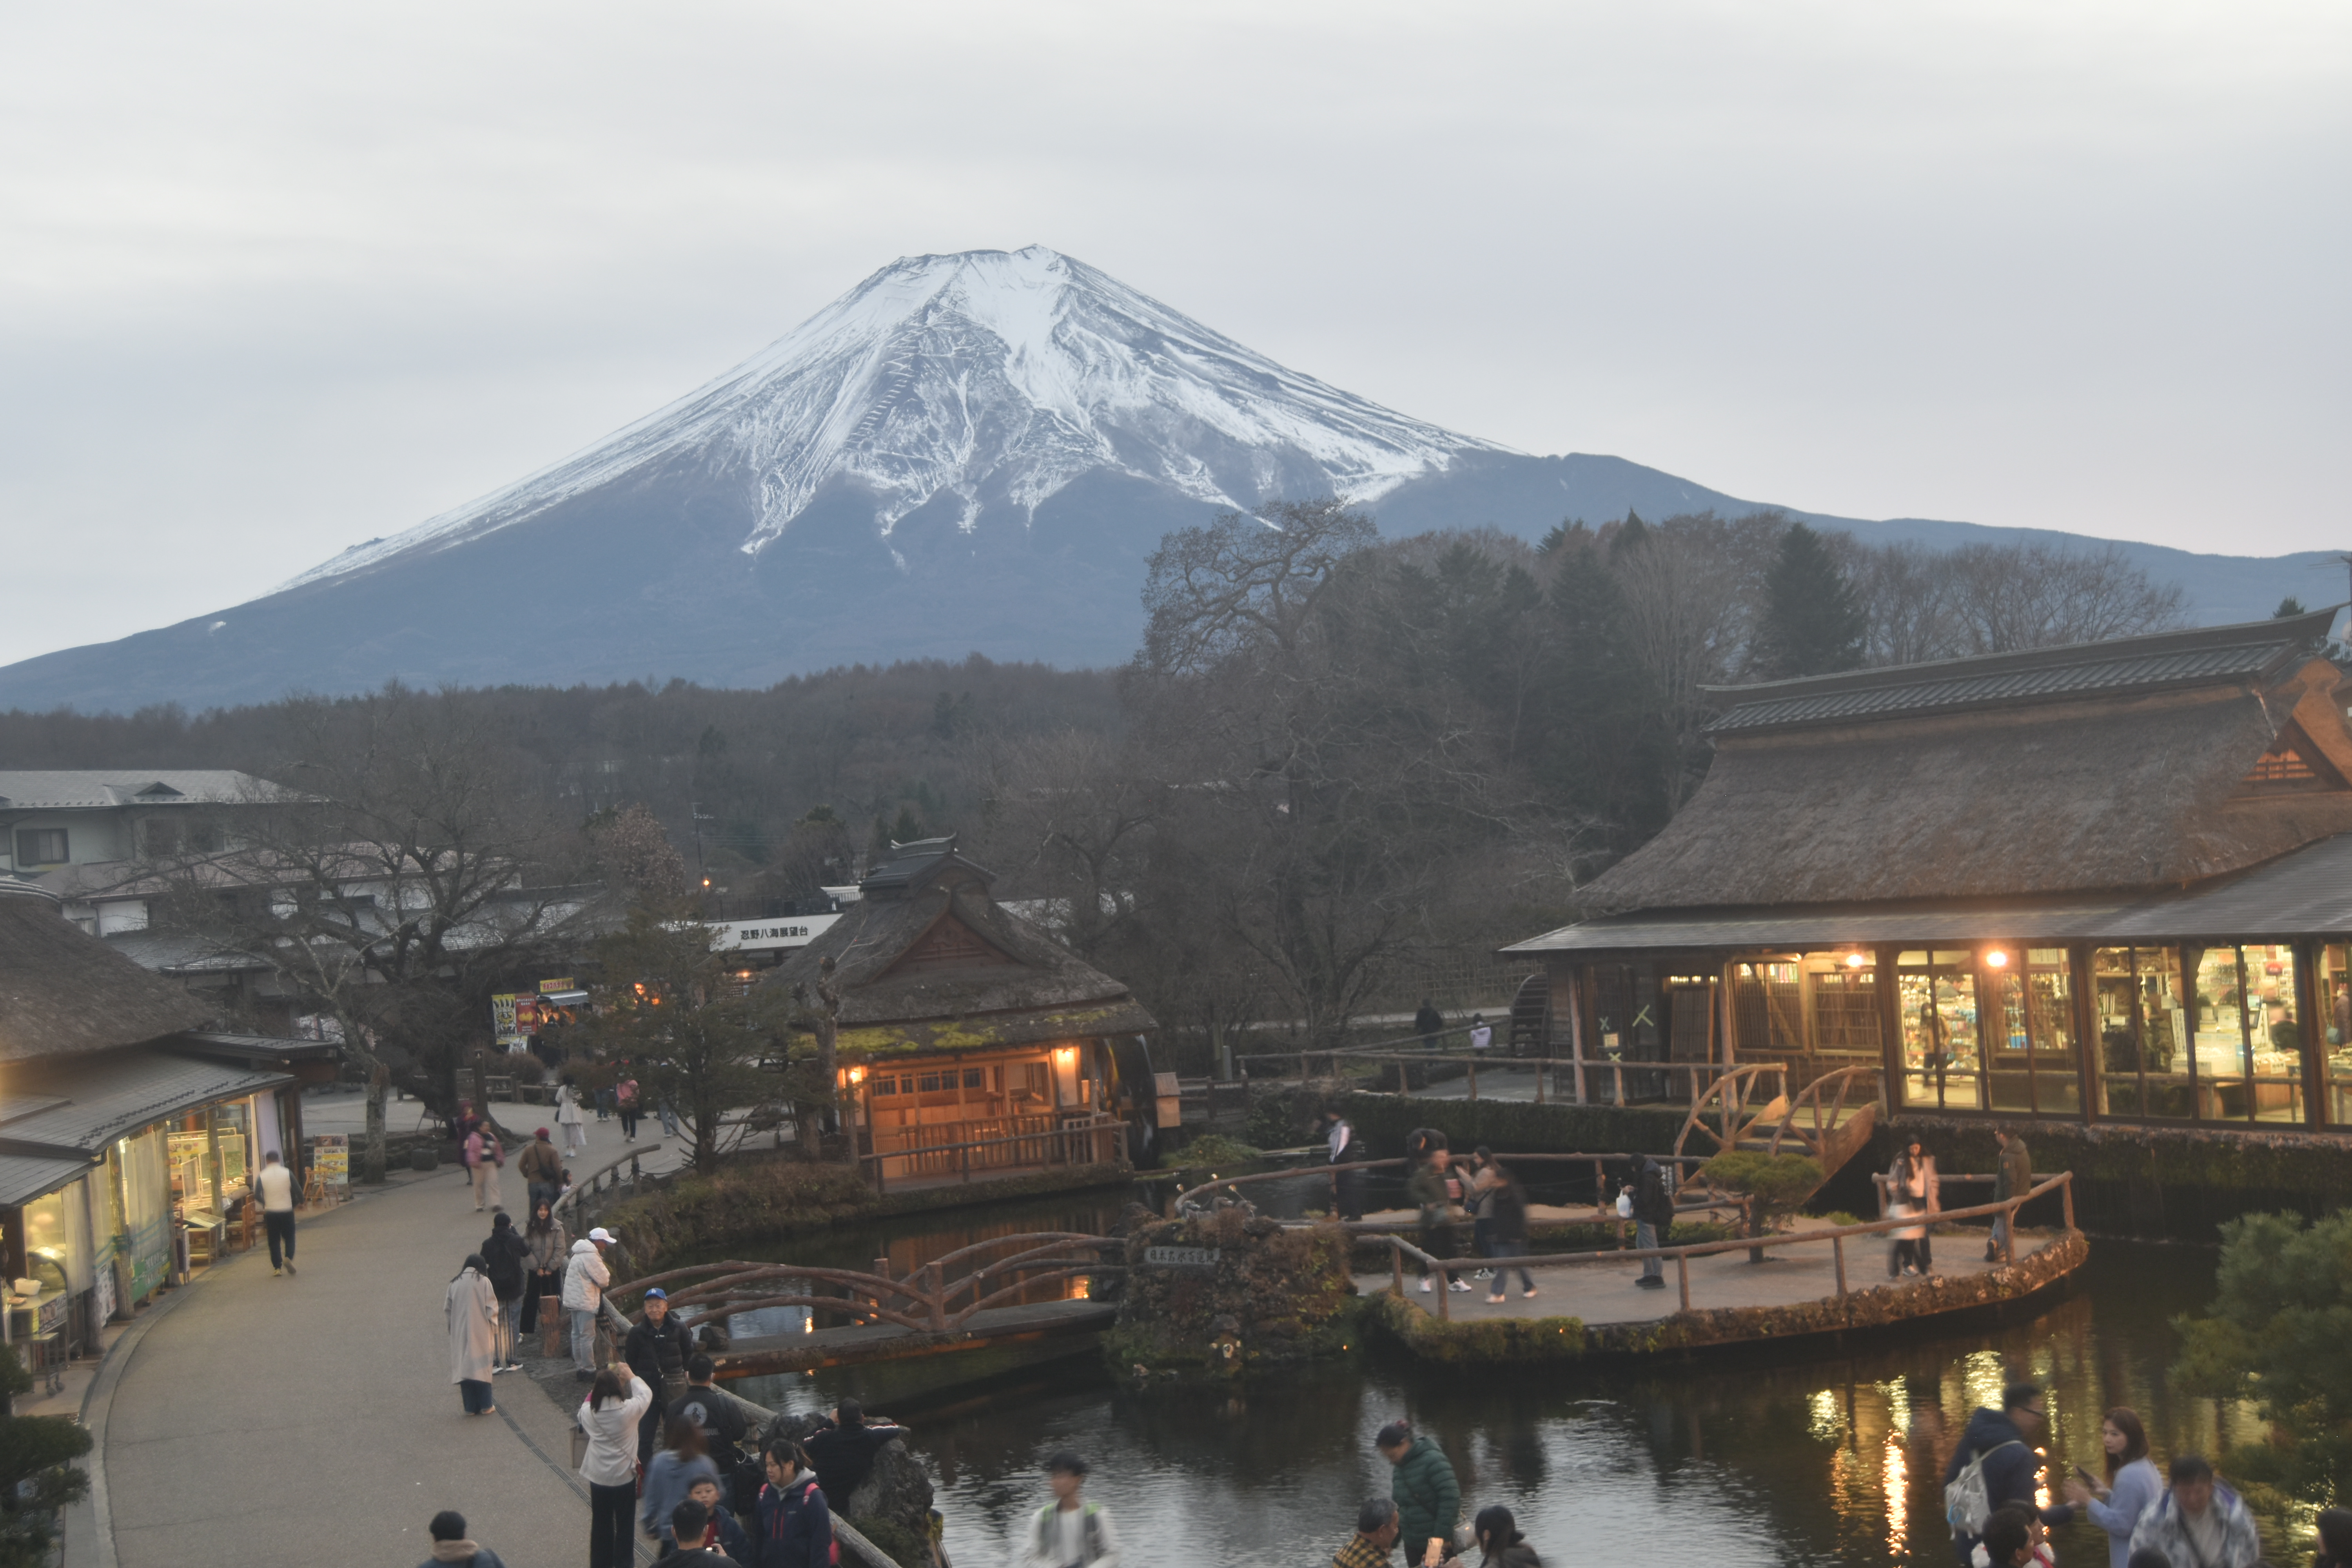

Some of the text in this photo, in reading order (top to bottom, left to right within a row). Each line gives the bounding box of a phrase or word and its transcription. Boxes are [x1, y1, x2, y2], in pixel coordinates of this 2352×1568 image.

[740, 926, 808, 940] 忍野八海展望台
